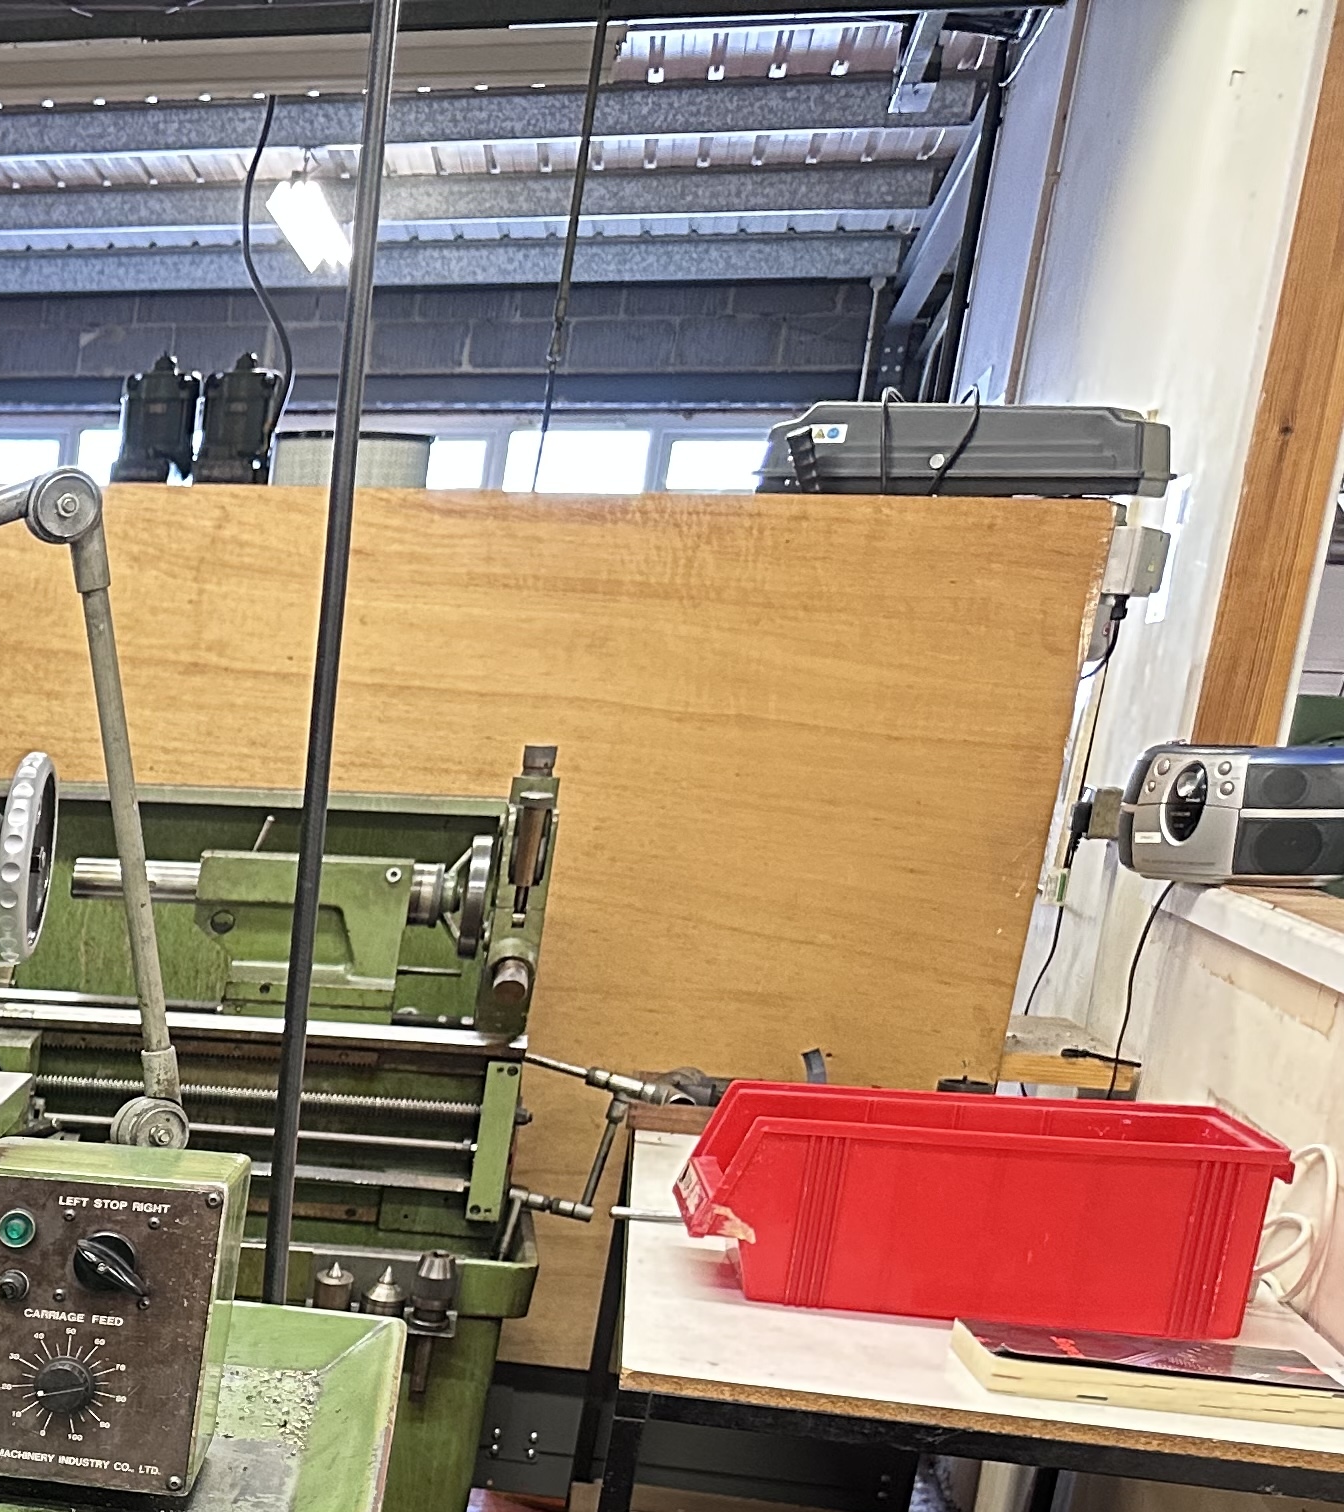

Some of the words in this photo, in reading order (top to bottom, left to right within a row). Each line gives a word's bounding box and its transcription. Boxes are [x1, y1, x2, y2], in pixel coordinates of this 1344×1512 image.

[58, 1195, 90, 1207] LEFT
[93, 1198, 128, 1211] STOP
[132, 1201, 171, 1214] RIGHT
[23, 1308, 86, 1323] CARRIAGE
[91, 1314, 124, 1327] FEED
[58, 1455, 111, 1470] INDUSTRY
